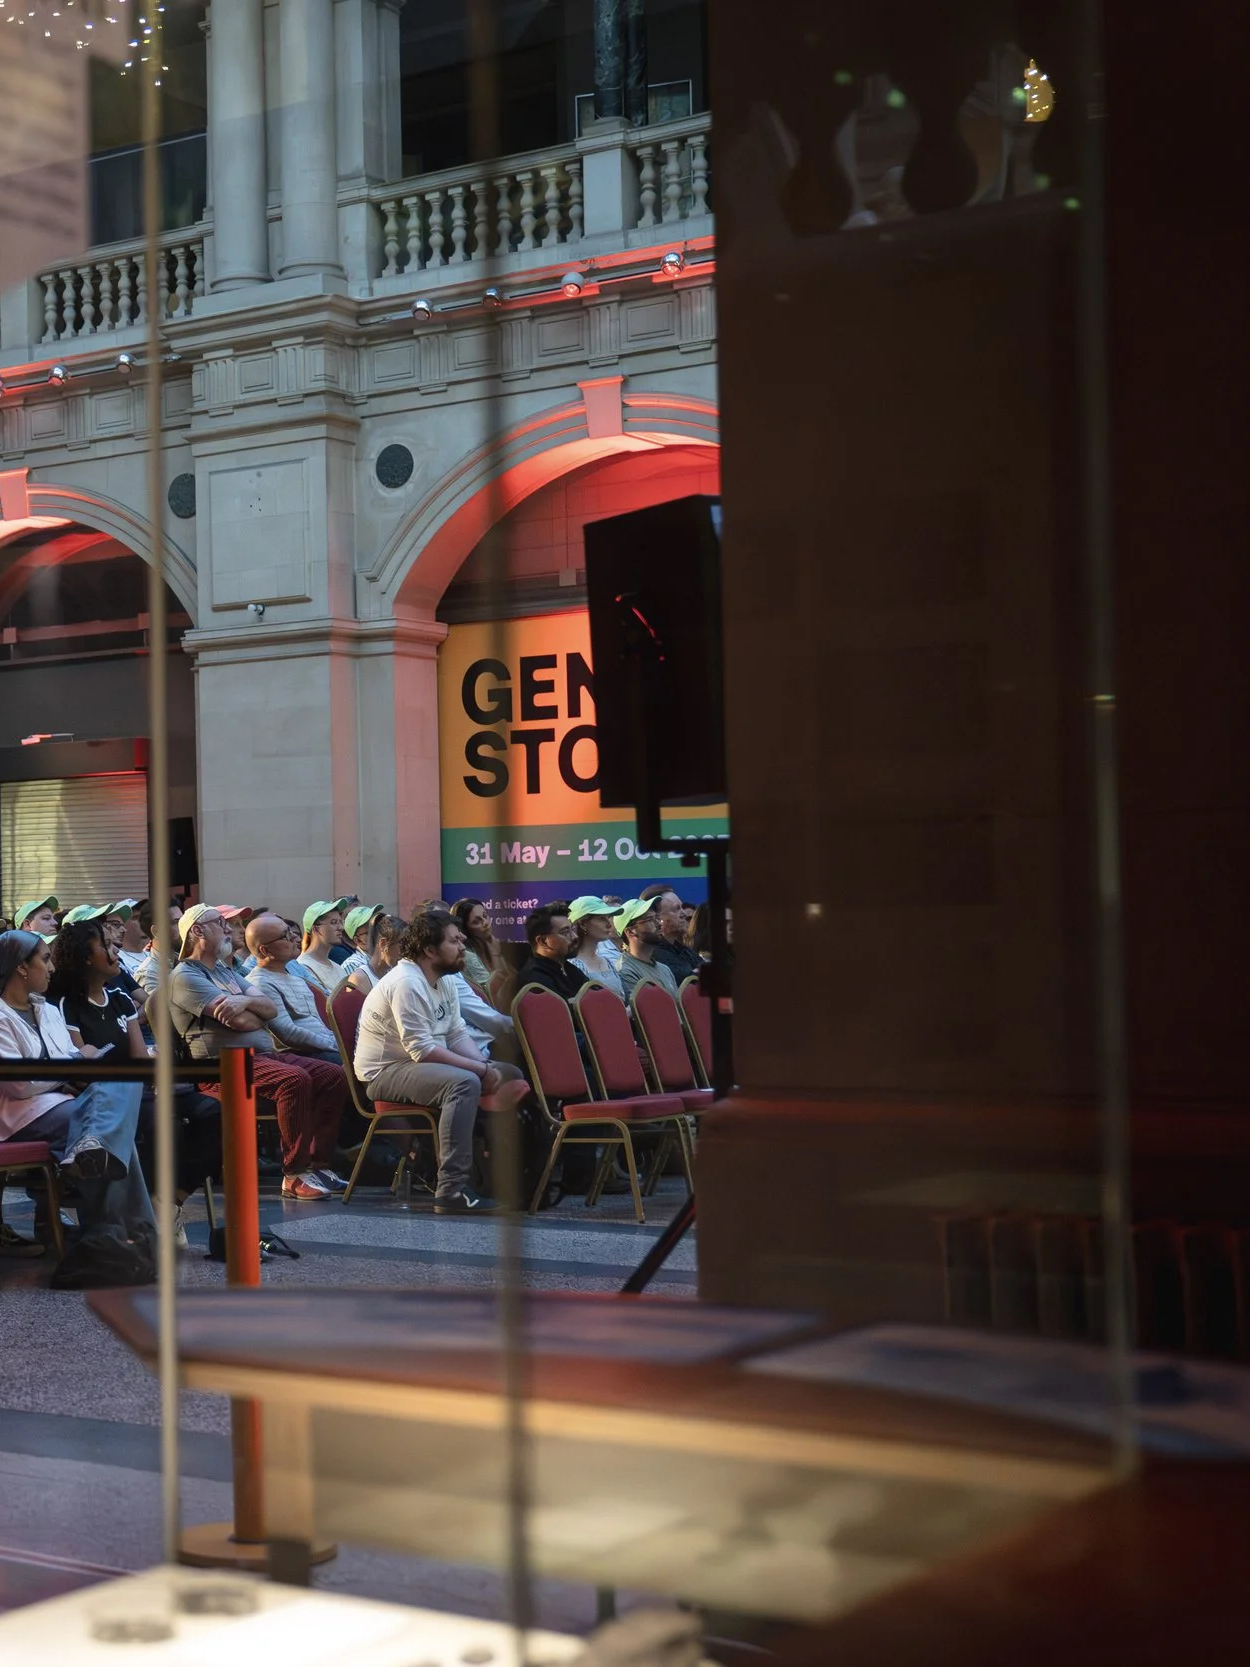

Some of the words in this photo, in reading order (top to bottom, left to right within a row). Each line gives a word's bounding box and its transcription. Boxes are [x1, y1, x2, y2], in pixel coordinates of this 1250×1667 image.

[465, 842, 493, 865] 31
[501, 841, 550, 868] May
[578, 838, 608, 862] 12
[503, 898, 539, 909] ticket?
